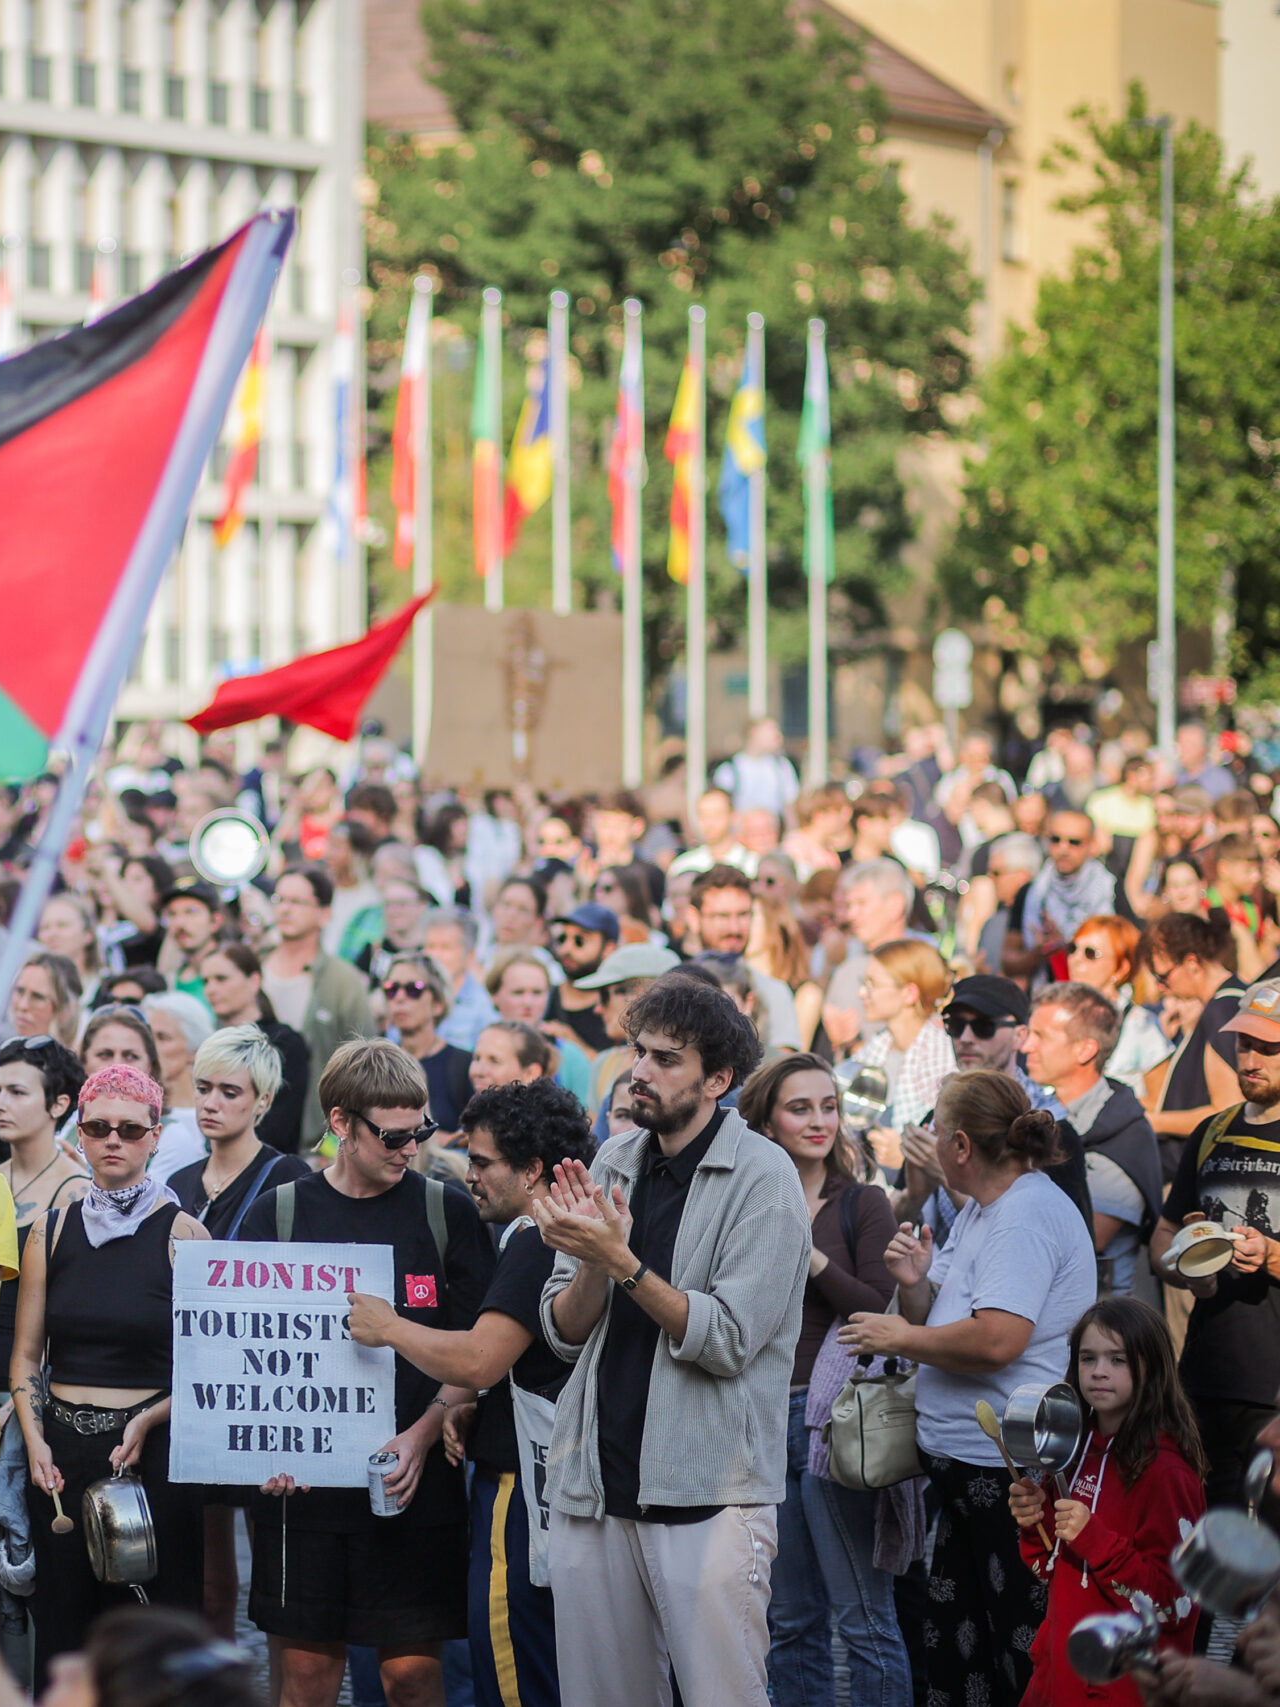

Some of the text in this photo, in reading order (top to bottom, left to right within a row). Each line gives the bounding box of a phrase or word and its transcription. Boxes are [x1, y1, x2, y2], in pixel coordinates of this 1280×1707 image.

[207, 1260, 361, 1293] ZIONIST
[242, 1349, 320, 1379] NOT
[192, 1383, 376, 1414] WELCOME
[227, 1424, 333, 1454] HERE
